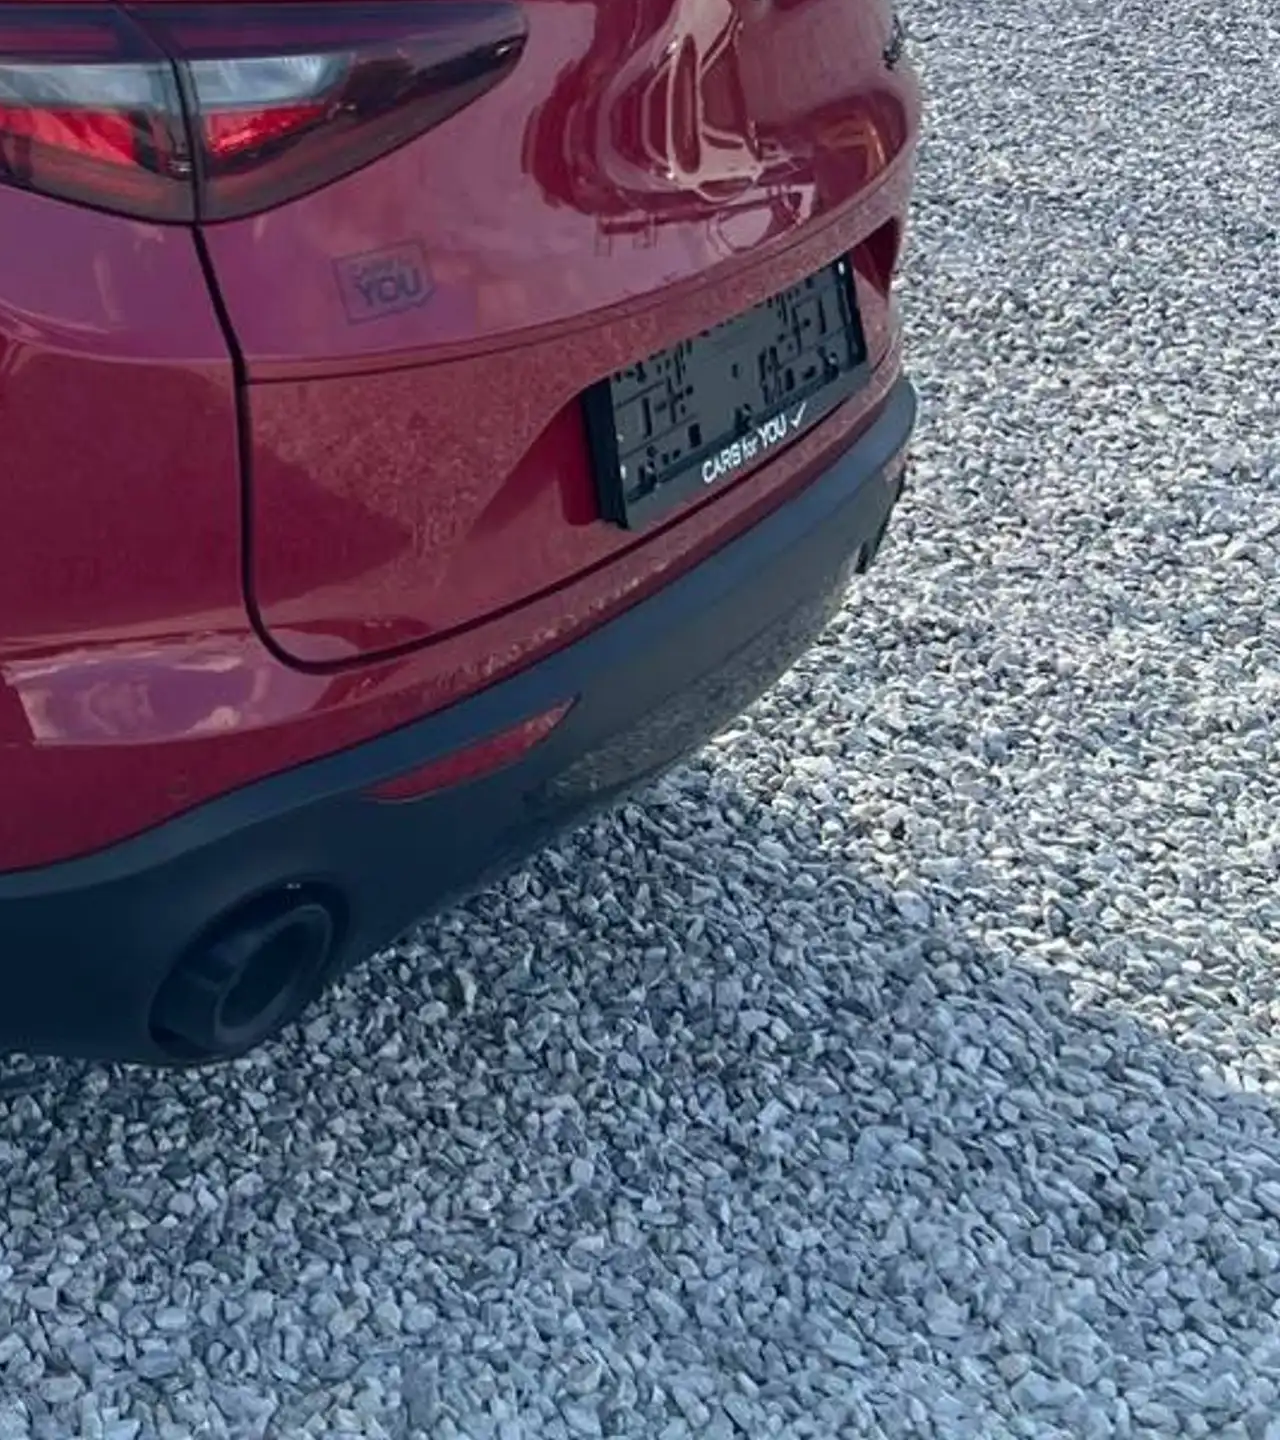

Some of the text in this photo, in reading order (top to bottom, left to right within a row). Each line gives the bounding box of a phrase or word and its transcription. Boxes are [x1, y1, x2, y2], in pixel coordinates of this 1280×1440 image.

[354, 265, 422, 308] YOU
[702, 441, 742, 484] CARS
[757, 413, 787, 449] YOU
